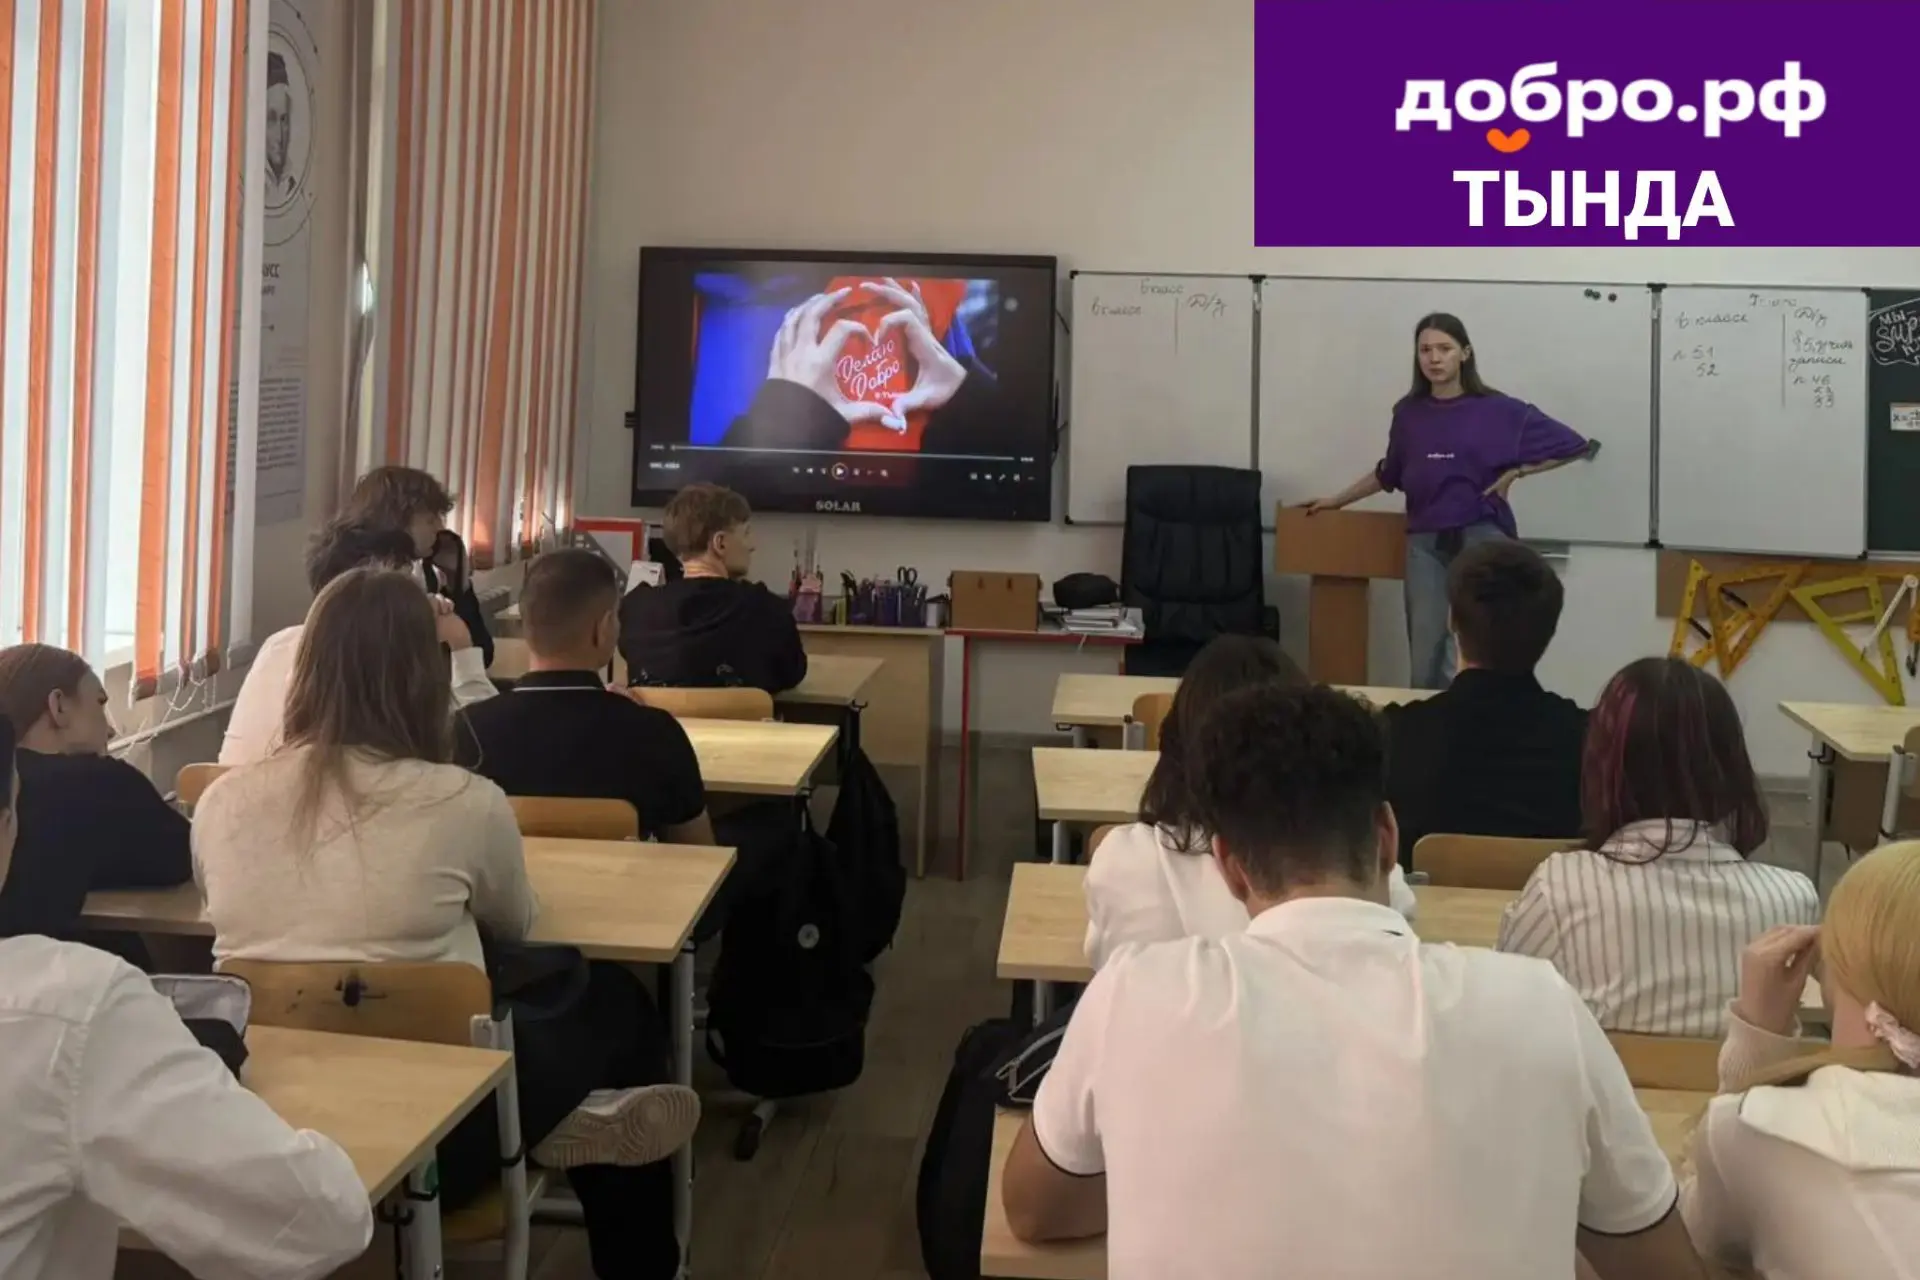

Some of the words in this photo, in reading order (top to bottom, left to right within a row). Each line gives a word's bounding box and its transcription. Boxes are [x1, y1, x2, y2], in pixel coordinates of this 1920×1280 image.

[836, 340, 896, 384] Делаю
[850, 358, 900, 402] Добро
[815, 499, 861, 512] SOLAR
